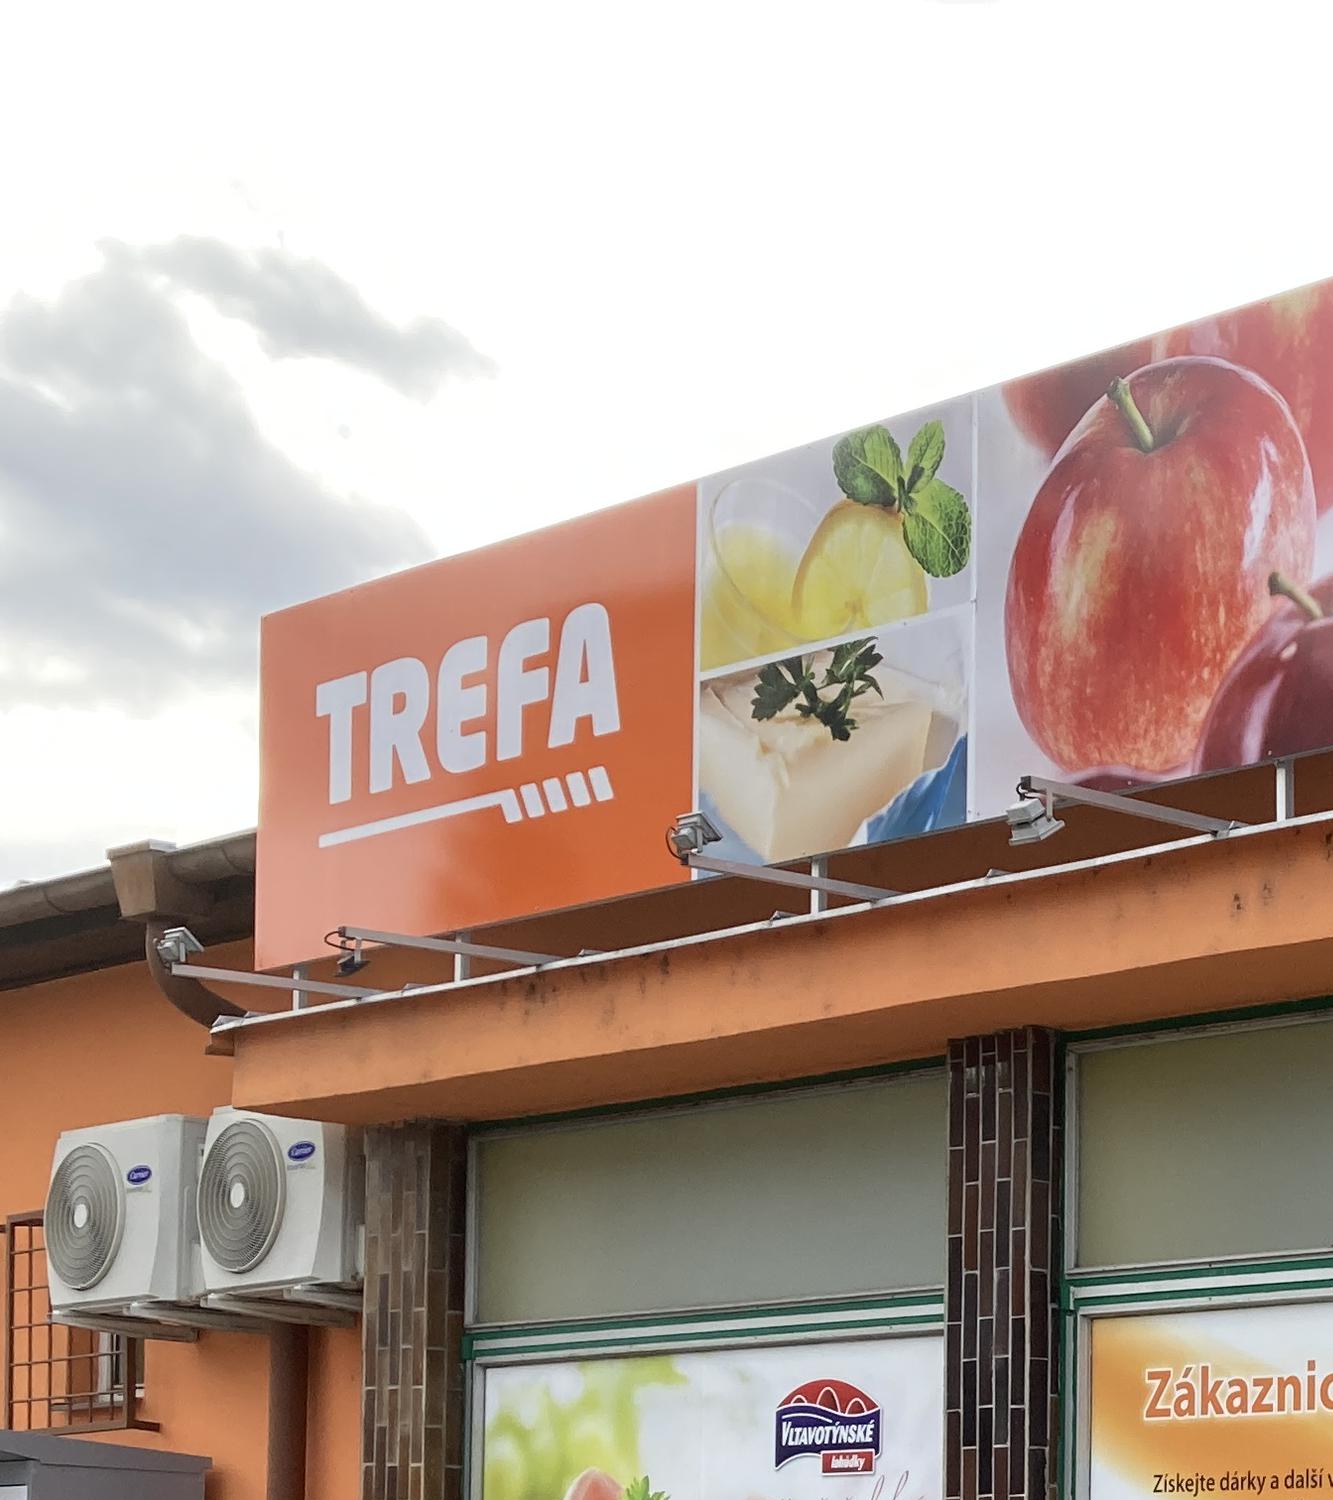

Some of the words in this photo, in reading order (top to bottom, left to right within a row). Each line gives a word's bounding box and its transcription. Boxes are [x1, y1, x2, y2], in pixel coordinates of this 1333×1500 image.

[316, 602, 621, 804] TREFA
[1153, 1474, 1215, 1497] Získejte
[1220, 1471, 1266, 1495] dárky
[1270, 1475, 1279, 1491] a
[1284, 1467, 1323, 1490] další
